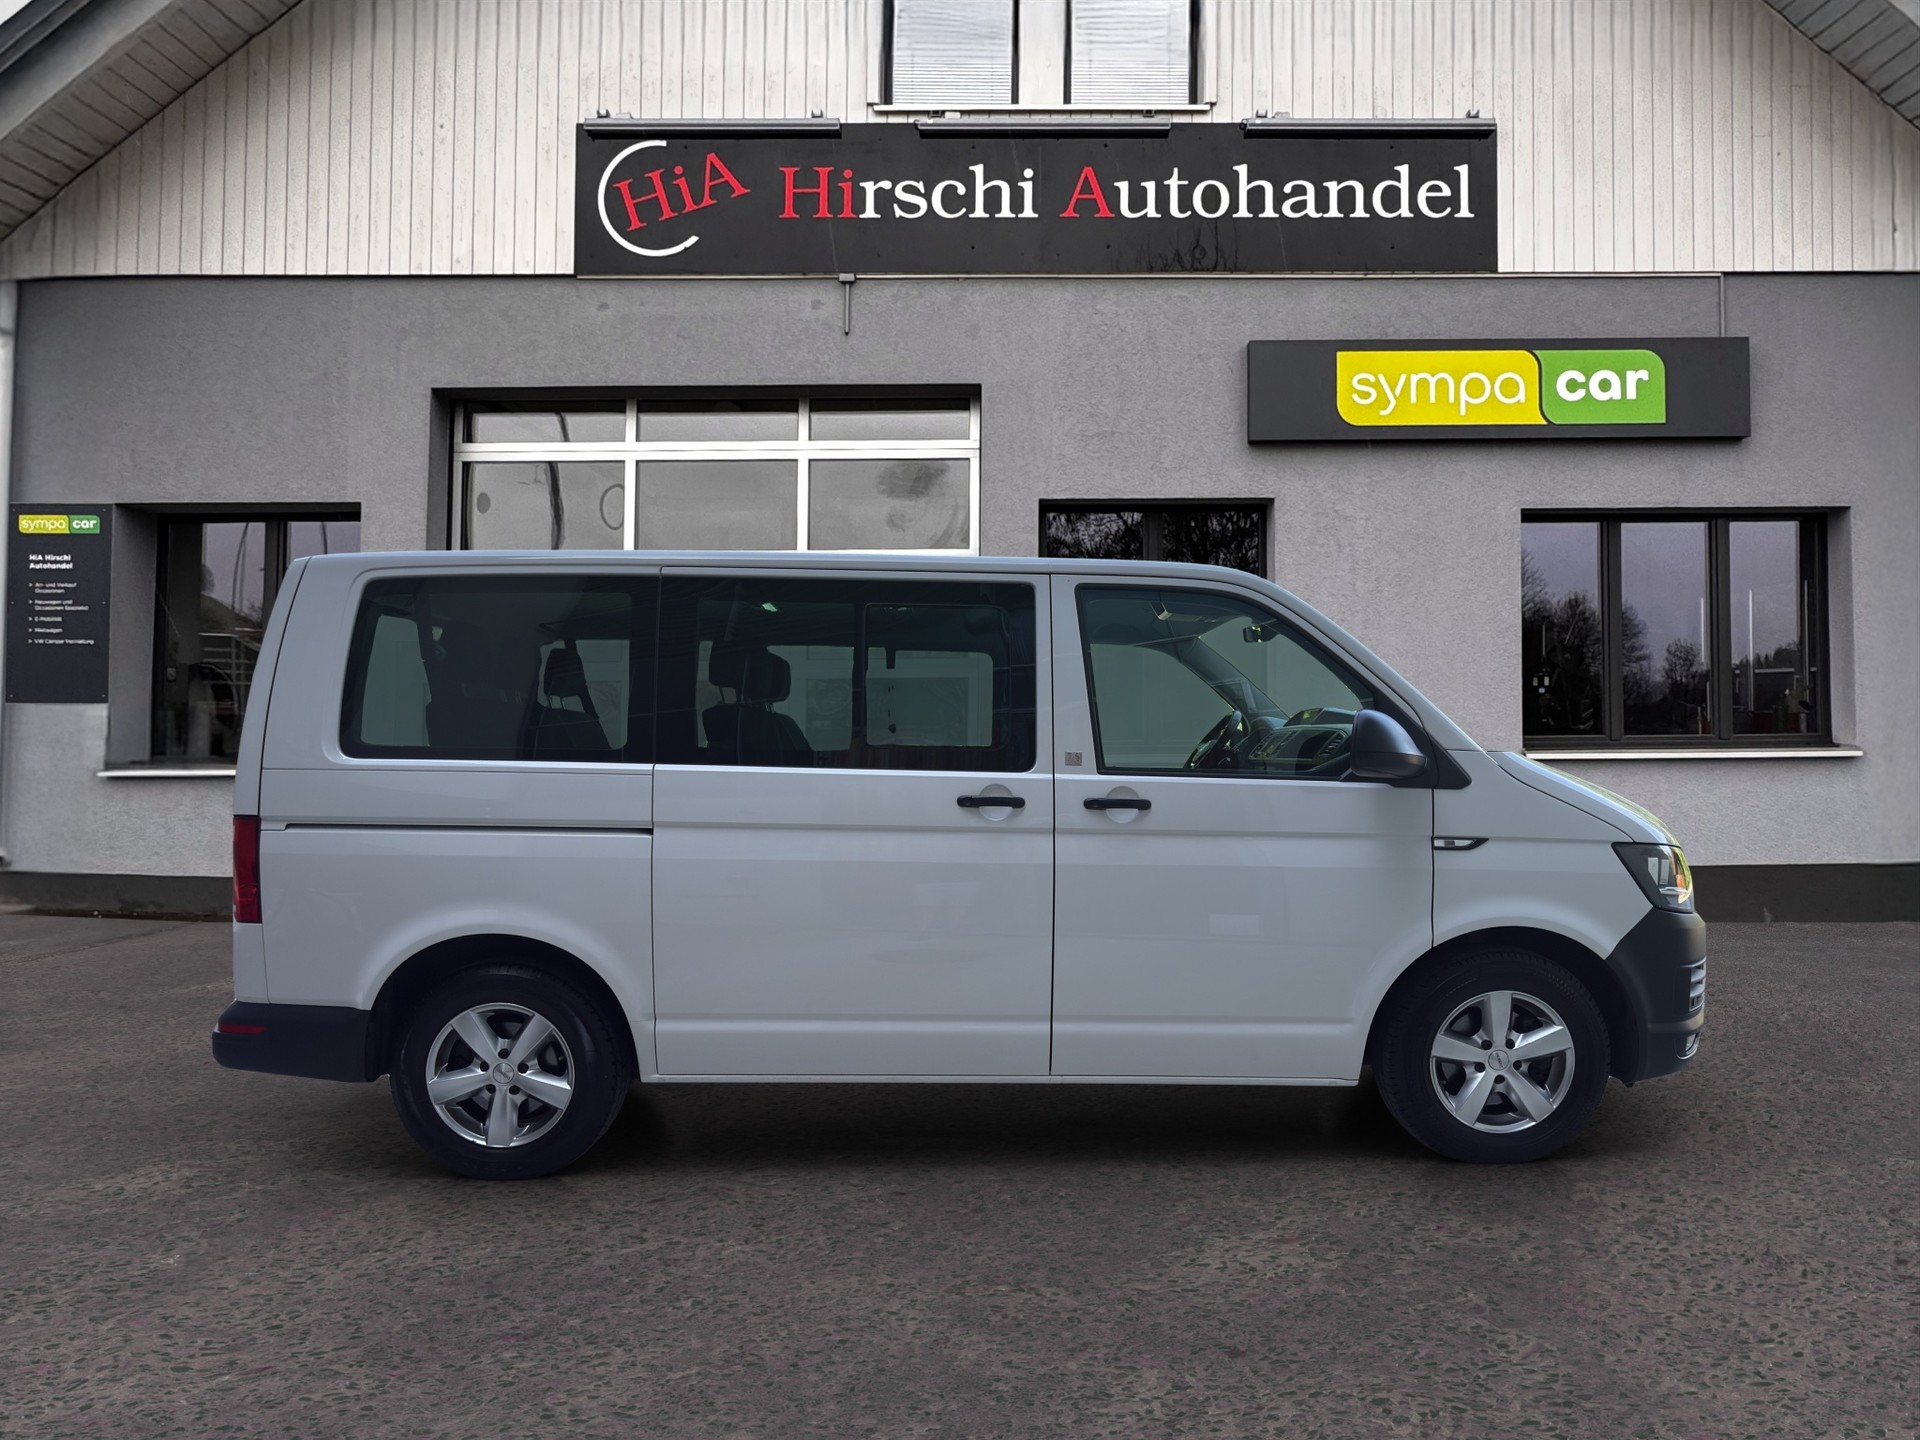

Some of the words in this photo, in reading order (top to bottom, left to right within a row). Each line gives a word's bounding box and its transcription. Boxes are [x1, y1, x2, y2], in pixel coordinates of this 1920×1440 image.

[613, 152, 751, 232] HiA
[778, 163, 1038, 219] Hirschi
[1059, 163, 1475, 219] Autohandel
[1350, 371, 1526, 416] sympa
[1556, 369, 1649, 402] car
[22, 519, 66, 531] sympa
[72, 519, 97, 529] car
